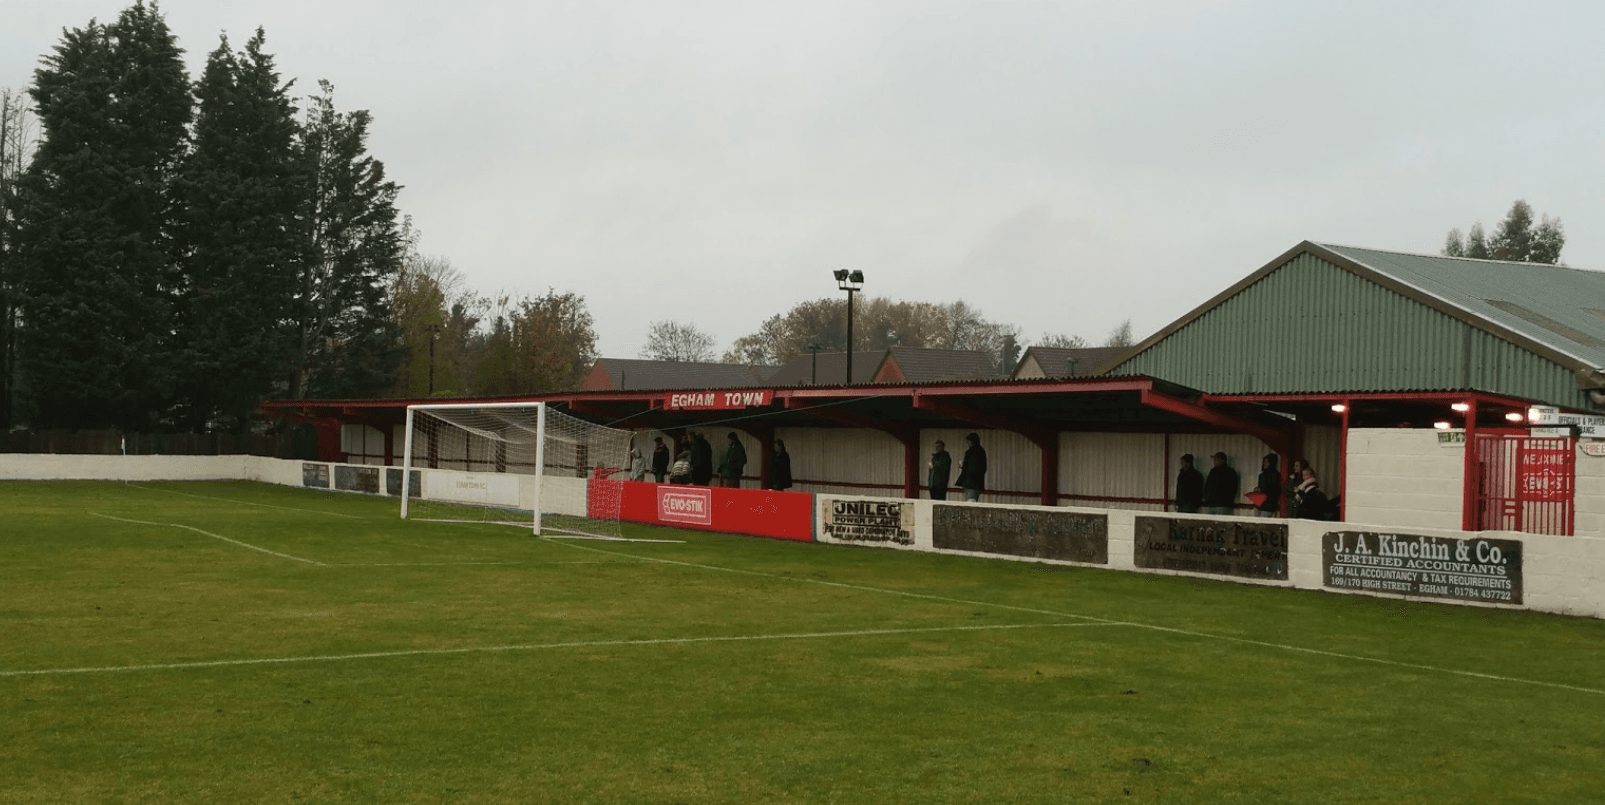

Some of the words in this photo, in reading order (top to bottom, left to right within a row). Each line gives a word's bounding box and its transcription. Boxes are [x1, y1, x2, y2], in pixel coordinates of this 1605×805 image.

[671, 393, 715, 407] EGHAM
[725, 392, 764, 406] TOWN
[670, 498, 703, 513] EVO-STIK
[868, 518, 898, 526] PLANT
[1149, 542, 1177, 552] LOCAL
[1333, 533, 1349, 553] J.
[1355, 534, 1372, 555] A.
[1378, 534, 1450, 560] Kinchin
[1455, 539, 1470, 562] &
[1475, 541, 1508, 564] Co.
[1335, 554, 1403, 567] CERTIFIED
[1406, 559, 1506, 575] ACCOUNTANTS
[1330, 566, 1344, 576] FOR
[1345, 567, 1359, 577] ALL
[1360, 568, 1417, 581] ACCOUNTANCY
[1422, 573, 1428, 582] &
[1430, 574, 1447, 583] TAX
[1449, 576, 1511, 589] REQUIREMENTS
[1331, 577, 1360, 587] 169/170
[1361, 579, 1381, 588] HIGH
[1382, 581, 1411, 591] STREET
[1419, 584, 1448, 595] EGHAM
[1454, 588, 1479, 598] 01784
[1480, 590, 1511, 600] 437722
